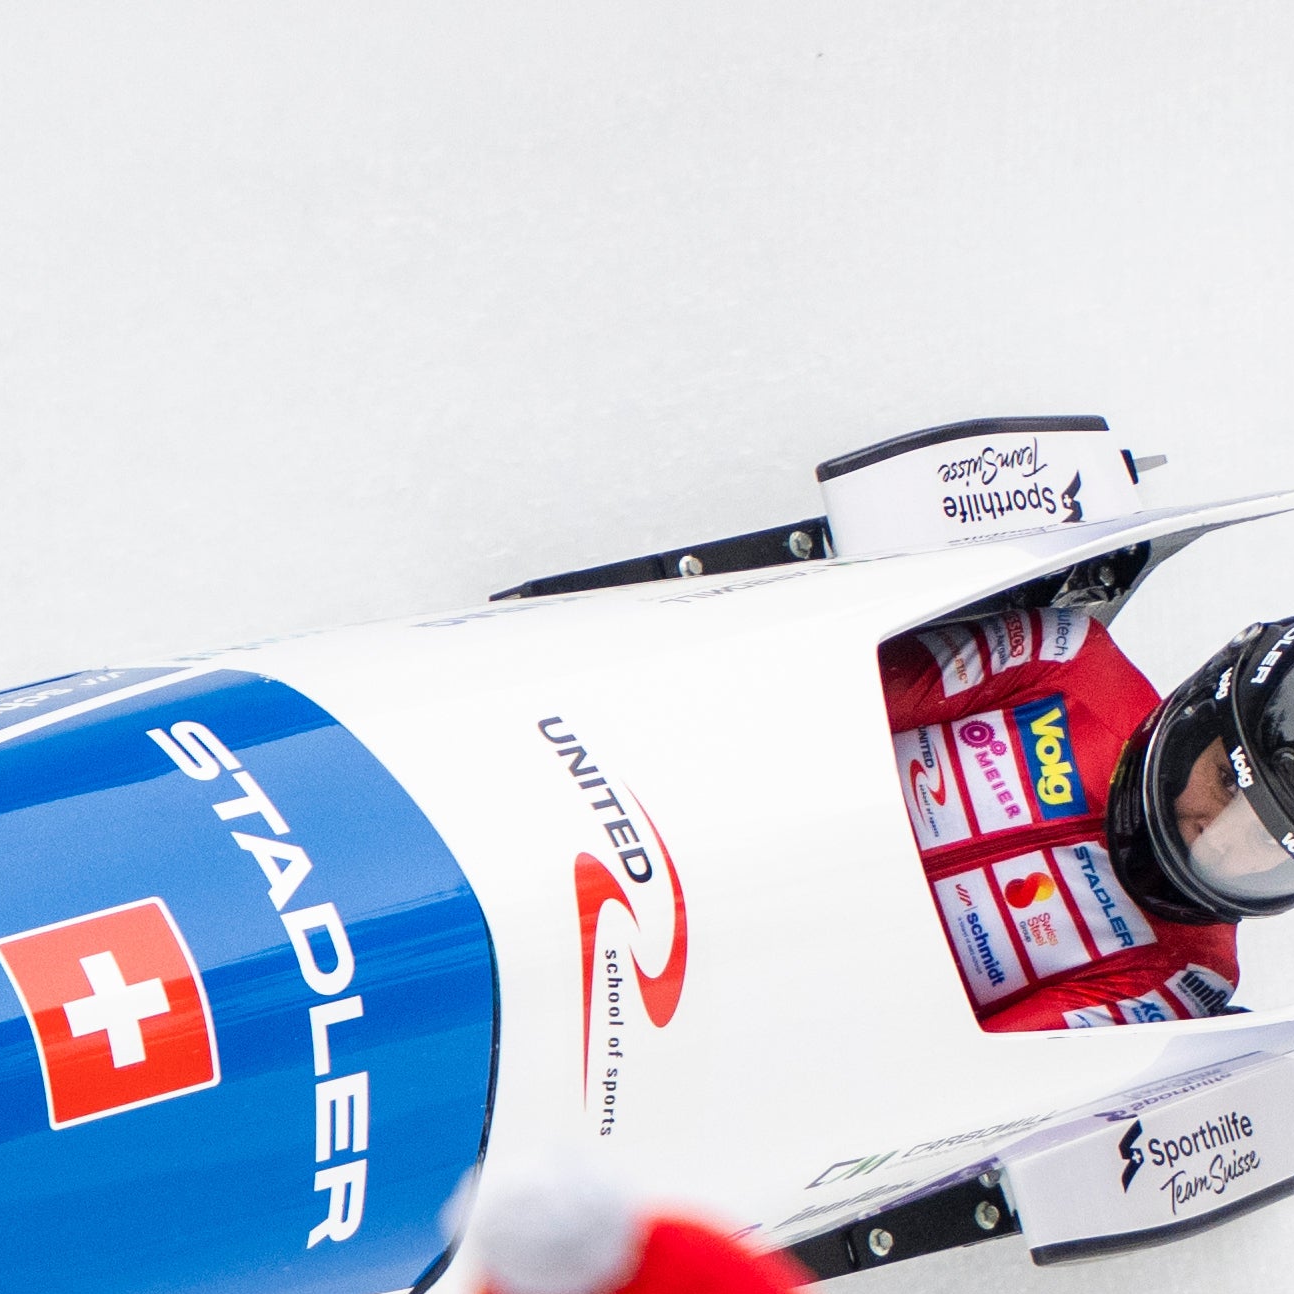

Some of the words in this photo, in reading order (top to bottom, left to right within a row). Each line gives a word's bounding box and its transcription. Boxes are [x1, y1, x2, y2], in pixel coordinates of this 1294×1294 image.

[943, 484, 1057, 523] Sporthilfe
[1215, 666, 1234, 700] Volg
[975, 751, 1021, 820] MEIER
[1030, 707, 1074, 806] Volg
[1230, 745, 1254, 789] Volg
[537, 715, 653, 884] UNITED
[1038, 912, 1059, 946] Swiss
[1073, 845, 1135, 948] STADLER
[966, 911, 1006, 987] schmidt
[1027, 916, 1046, 947] Steel
[146, 720, 371, 1249] STADLER
[604, 948, 624, 1027] school
[607, 1036, 624, 1059] of
[600, 1067, 619, 1138] sports
[1148, 1110, 1254, 1168] Sporthilfe
